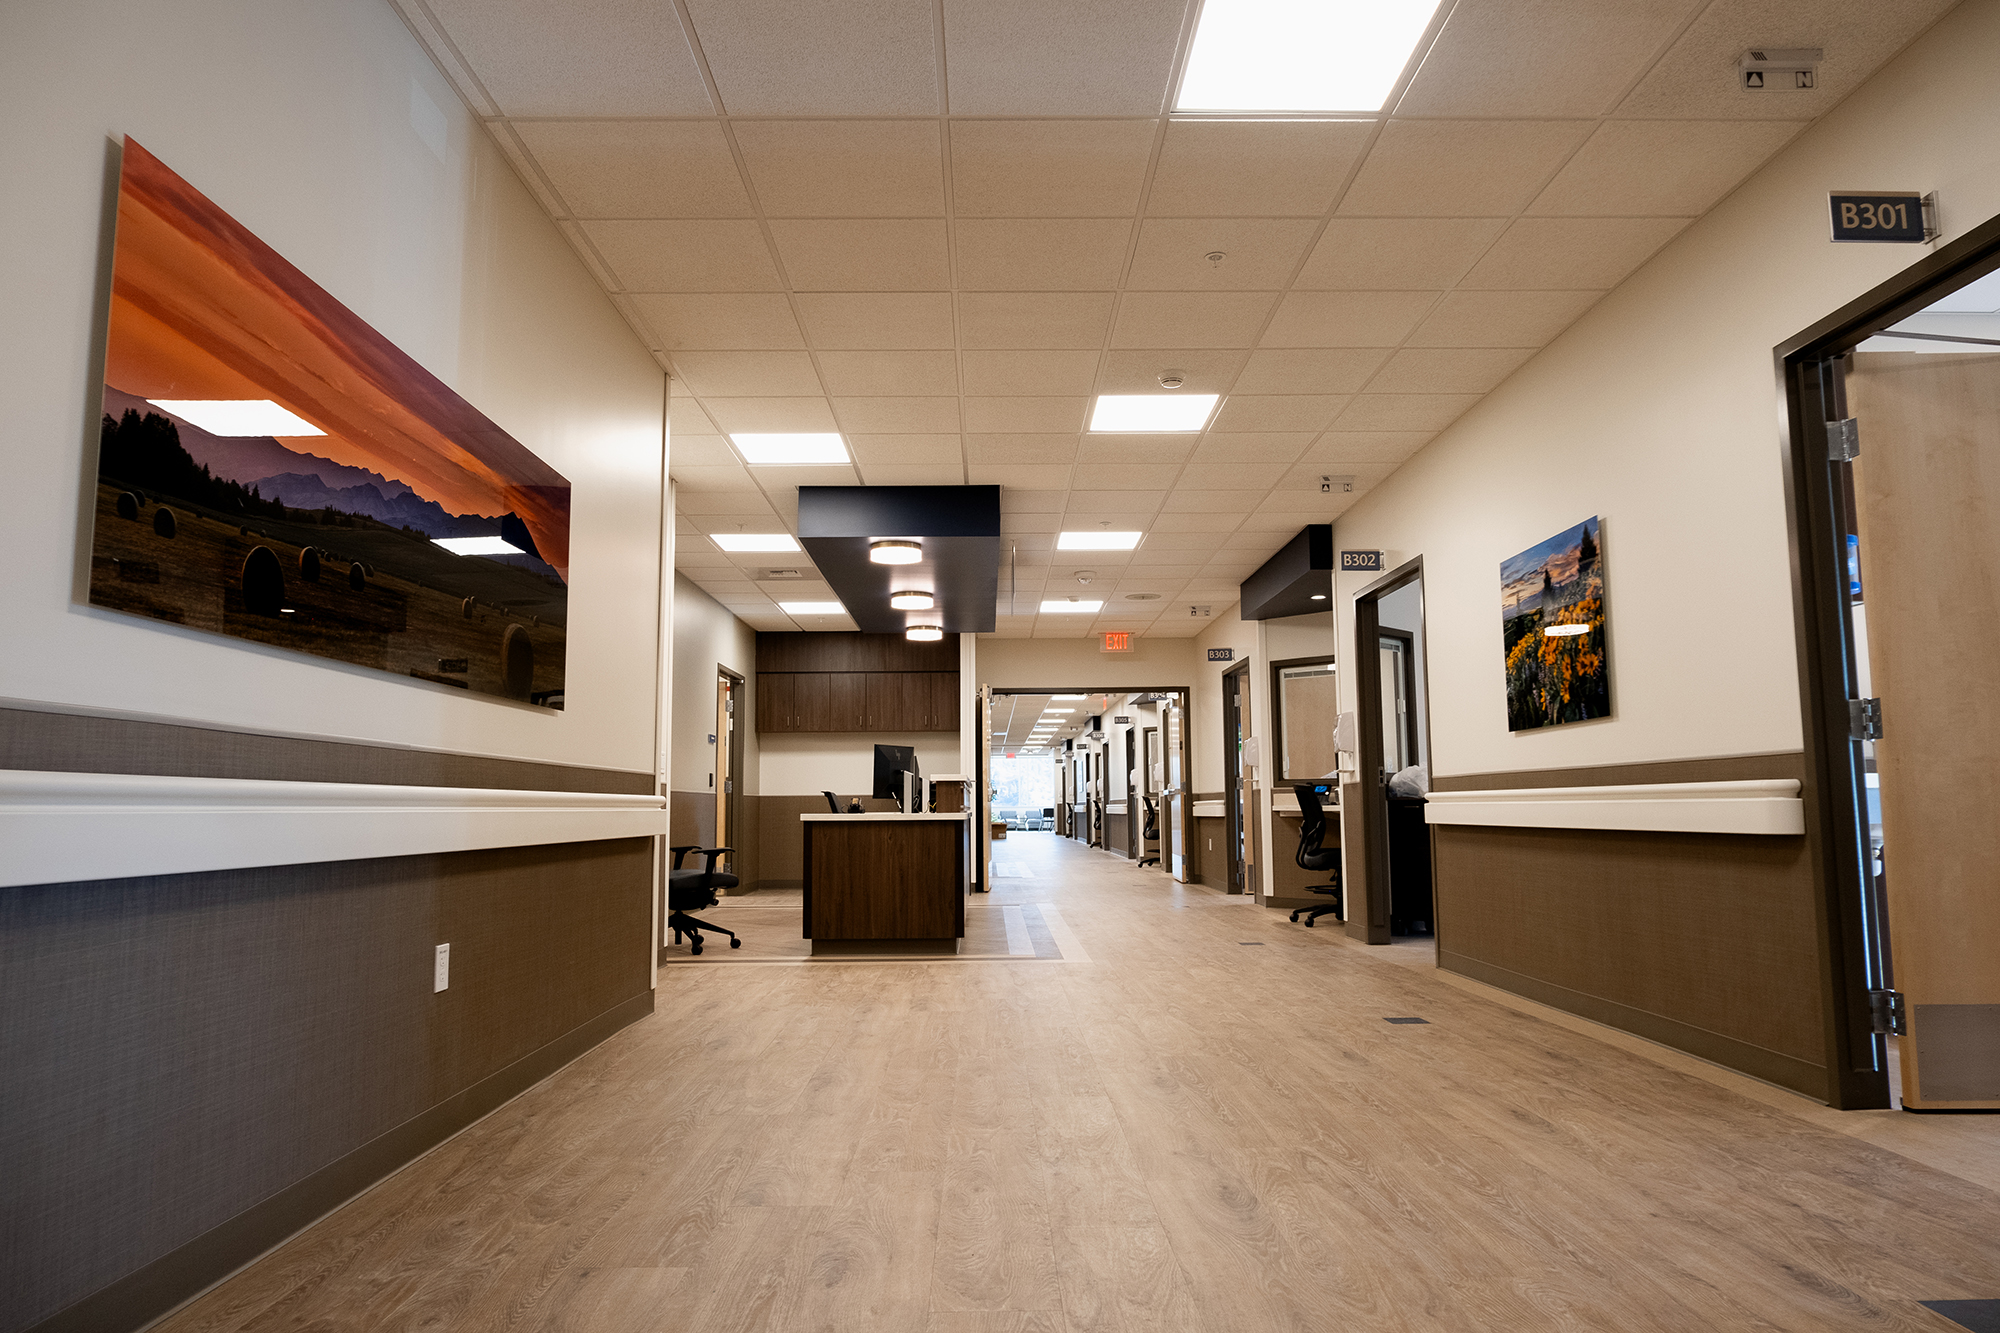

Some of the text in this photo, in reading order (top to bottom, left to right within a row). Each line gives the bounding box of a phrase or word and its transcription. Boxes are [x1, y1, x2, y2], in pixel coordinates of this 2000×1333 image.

[1841, 203, 1908, 230] B301
[1343, 554, 1376, 566] B302
[1106, 634, 1129, 650] EXIT
[1209, 650, 1230, 659] B303
